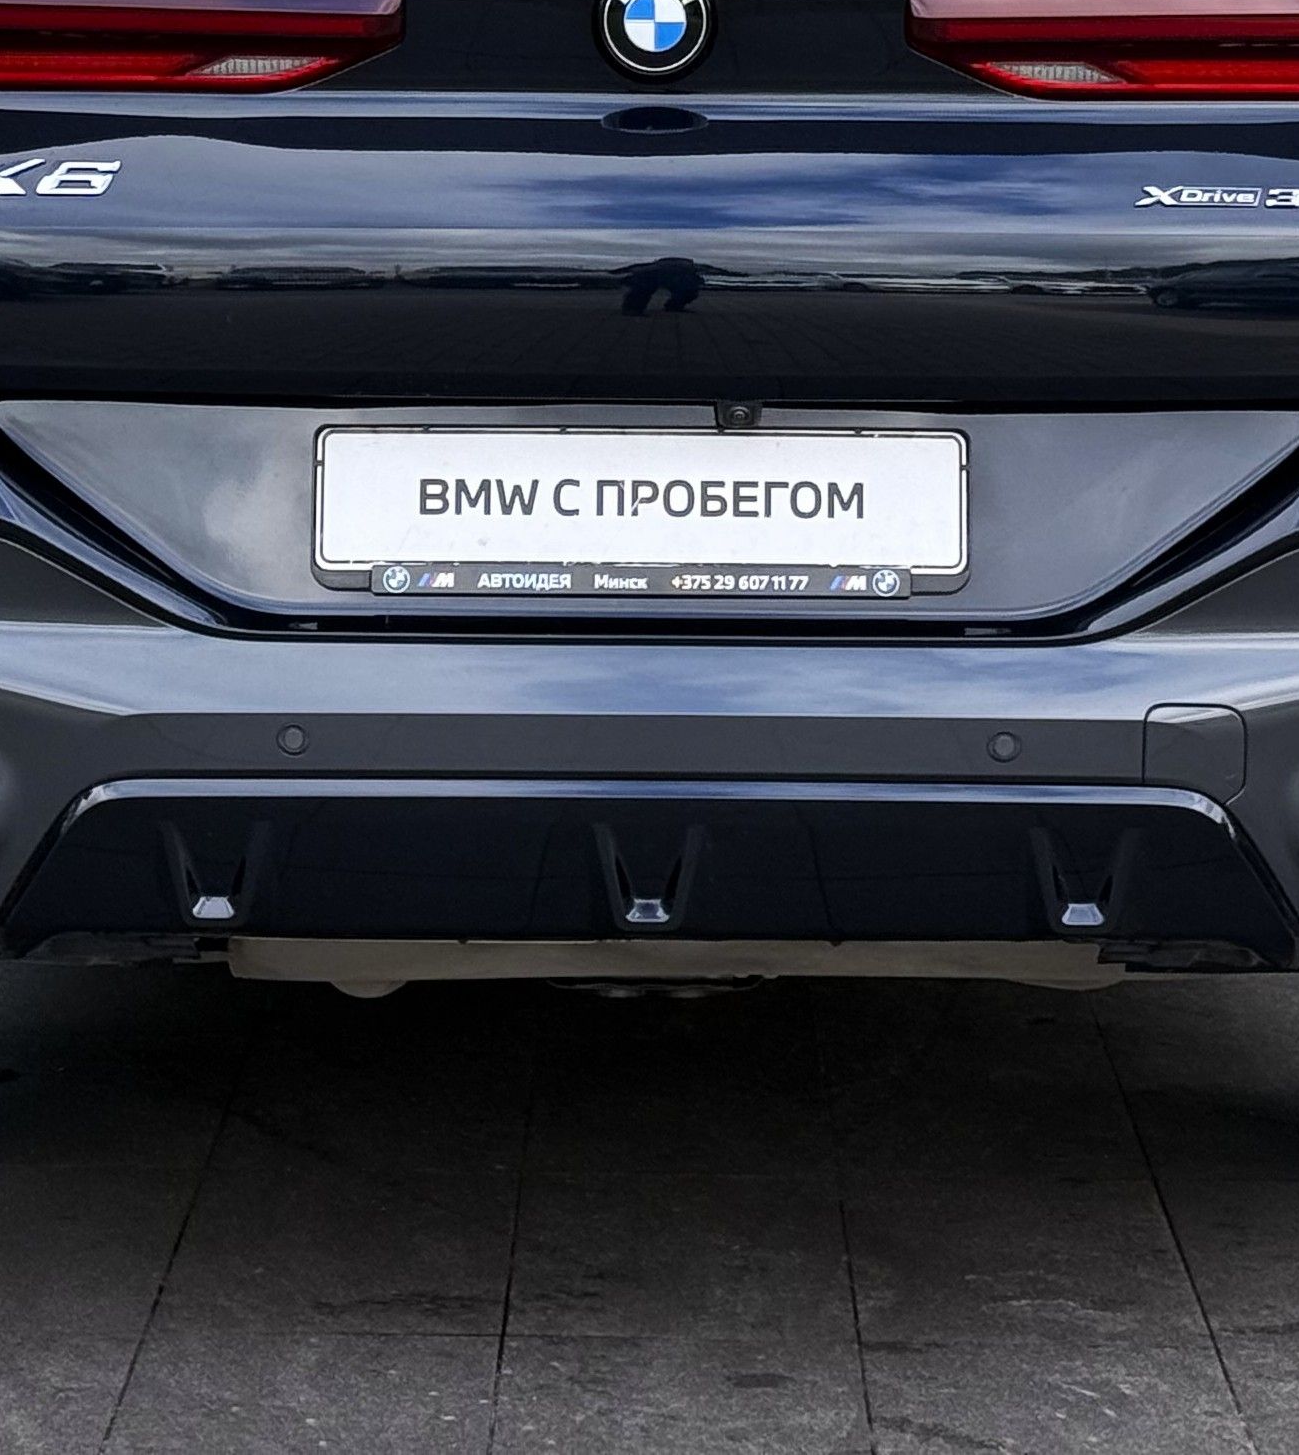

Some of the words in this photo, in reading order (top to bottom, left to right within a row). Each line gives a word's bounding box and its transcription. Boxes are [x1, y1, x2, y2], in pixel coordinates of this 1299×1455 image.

[419, 478, 539, 517] BMW
[553, 478, 580, 517] С
[596, 479, 864, 519] ПРОБЕГОМ
[477, 573, 572, 591] АВТОИДЕЯ
[594, 575, 648, 590] Минск
[671, 574, 711, 590] +375
[713, 575, 735, 590] 29
